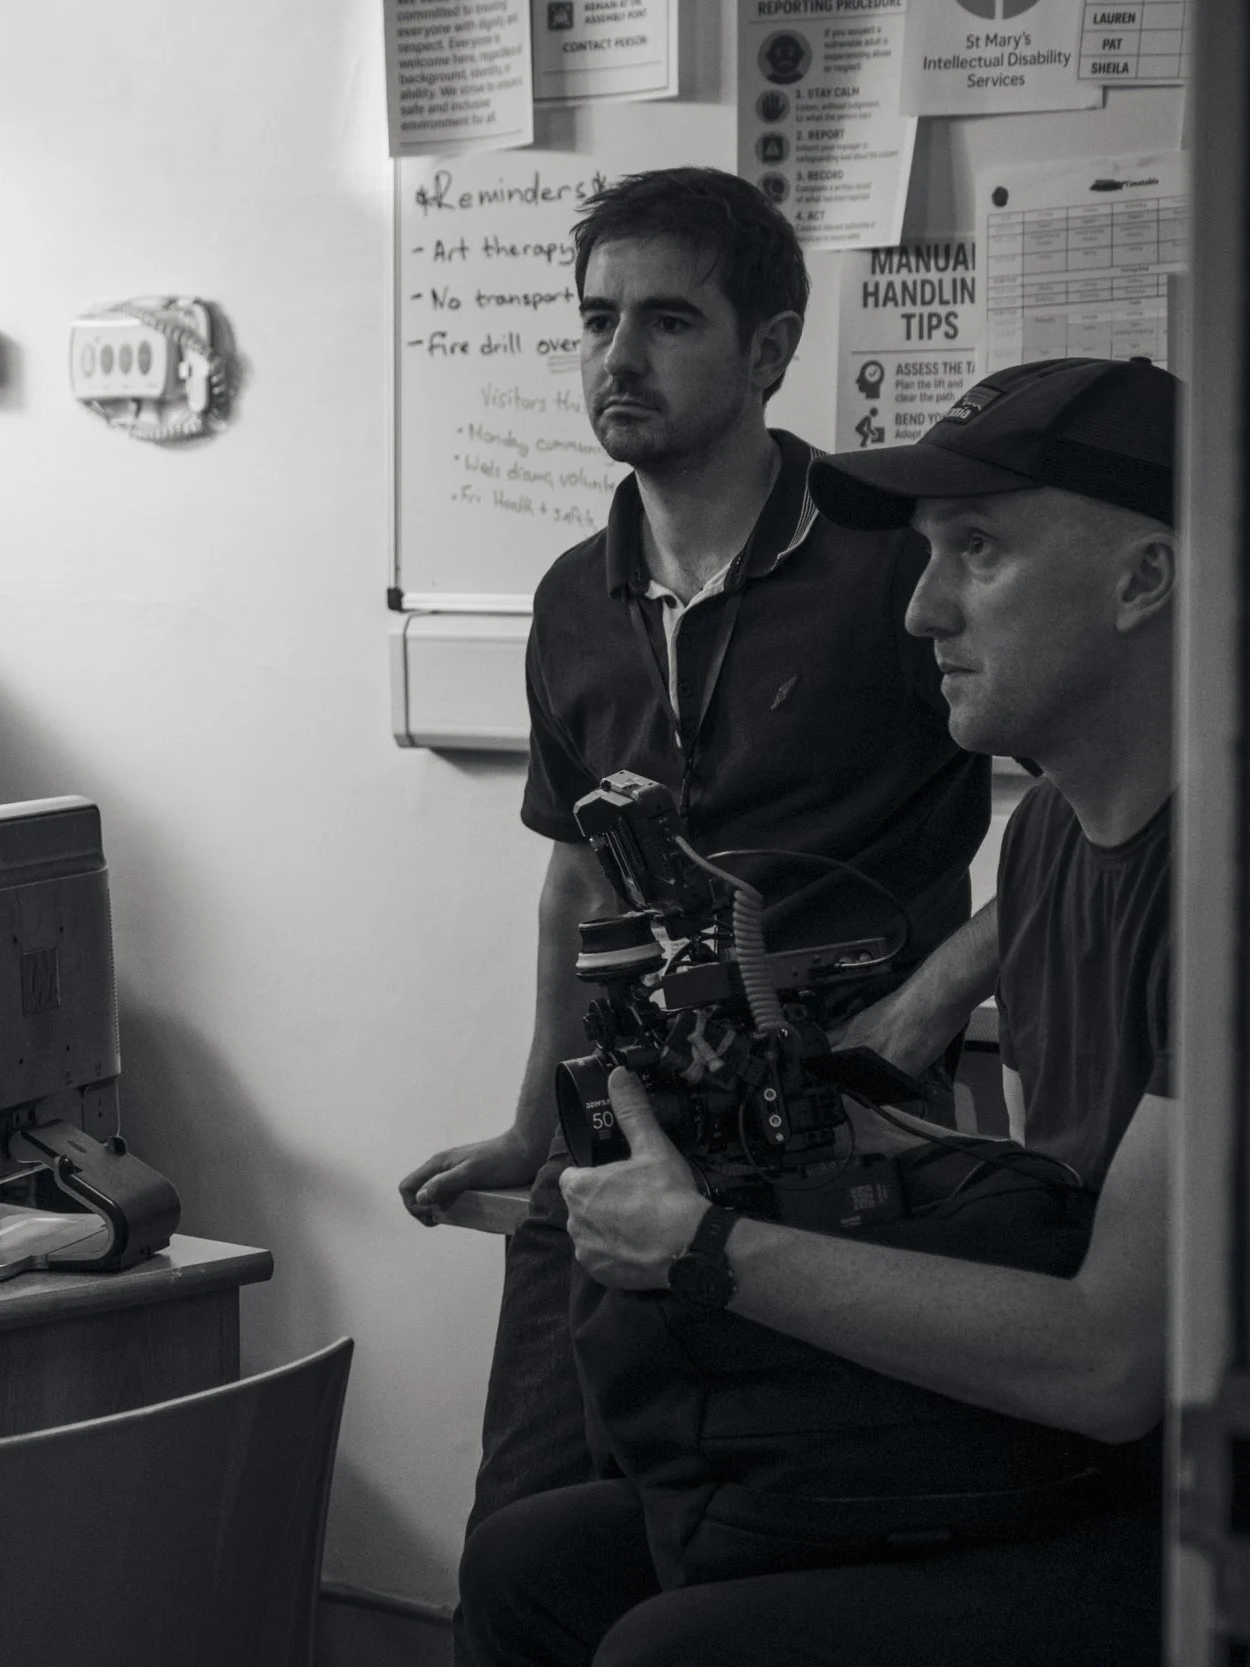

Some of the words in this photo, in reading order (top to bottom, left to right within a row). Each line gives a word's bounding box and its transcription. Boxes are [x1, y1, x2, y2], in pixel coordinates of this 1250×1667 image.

[758, 0, 833, 16] REPORTING
[1092, 11, 1137, 25] LAUREN
[562, 38, 611, 53] CONTACT
[966, 33, 980, 50] St
[985, 31, 1032, 50] Mary's
[1101, 38, 1124, 51] PAT
[922, 51, 1005, 71] Intellectual
[1008, 49, 1072, 68] Disability
[1091, 61, 1130, 75] SHEILA
[967, 73, 1026, 89] Services
[807, 87, 832, 99] STAY
[834, 86, 860, 98] CALM
[808, 127, 845, 141] REPORT
[807, 169, 844, 181] RECORD
[807, 209, 826, 221] ACT
[434, 237, 470, 262] Art
[482, 234, 576, 266] therapy
[431, 286, 461, 311] No
[475, 286, 576, 312] transport
[862, 276, 976, 309] HANDLIN
[901, 311, 959, 341] TIPS
[480, 330, 522, 356] drill
[536, 336, 582, 355] over
[896, 361, 939, 376] ASSESS
[942, 360, 963, 376] THE
[895, 379, 915, 390] Plan
[917, 379, 932, 389] the
[947, 379, 964, 389] and
[895, 391, 918, 403] clear
[919, 391, 934, 403] the
[895, 411, 925, 426] BEND
[592, 1110, 614, 1130] 50
